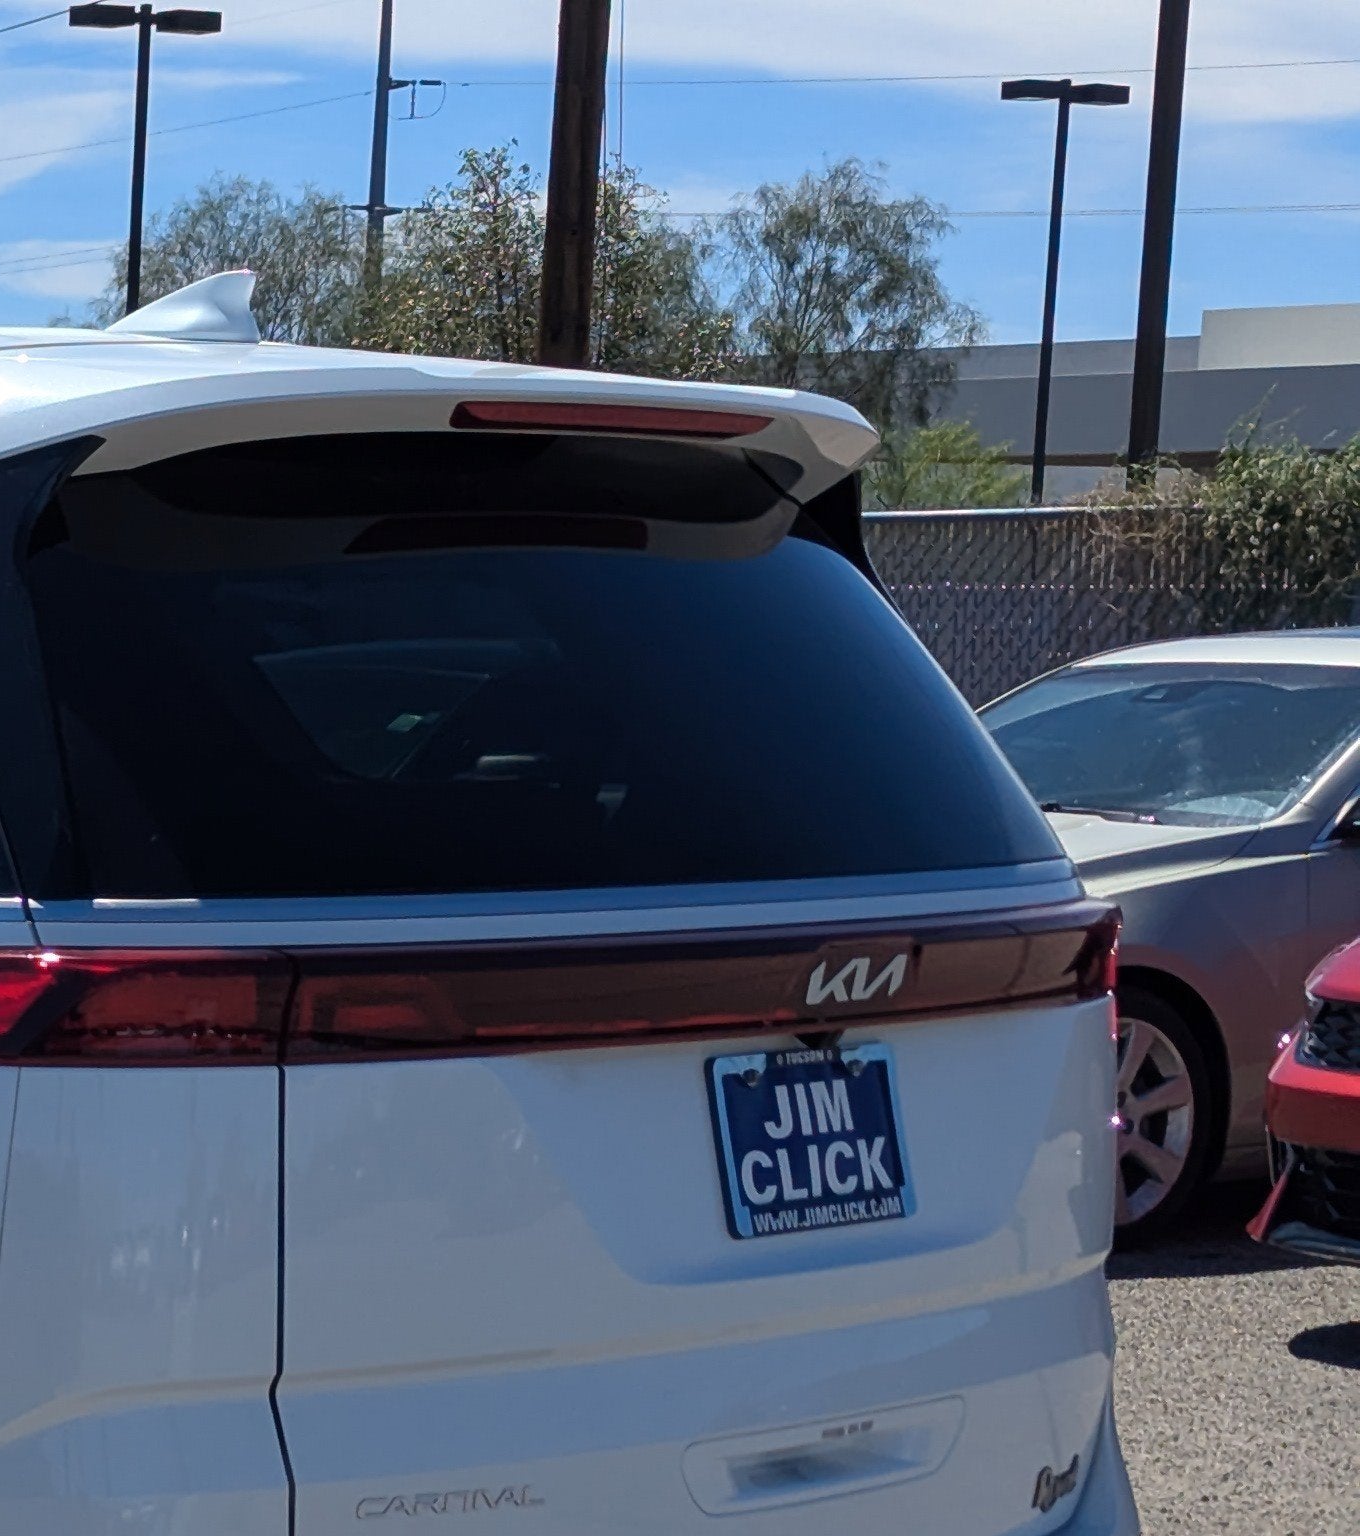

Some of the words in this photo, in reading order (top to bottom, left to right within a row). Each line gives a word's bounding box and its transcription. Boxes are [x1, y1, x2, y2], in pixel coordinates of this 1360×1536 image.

[785, 1049, 826, 1065] TUCSON
[764, 1079, 855, 1139] JIM
[741, 1136, 894, 1206] CLICK
[753, 1196, 902, 1233] WWW.JIMCLICK.COM
[356, 1484, 546, 1520] CARNIVAL
